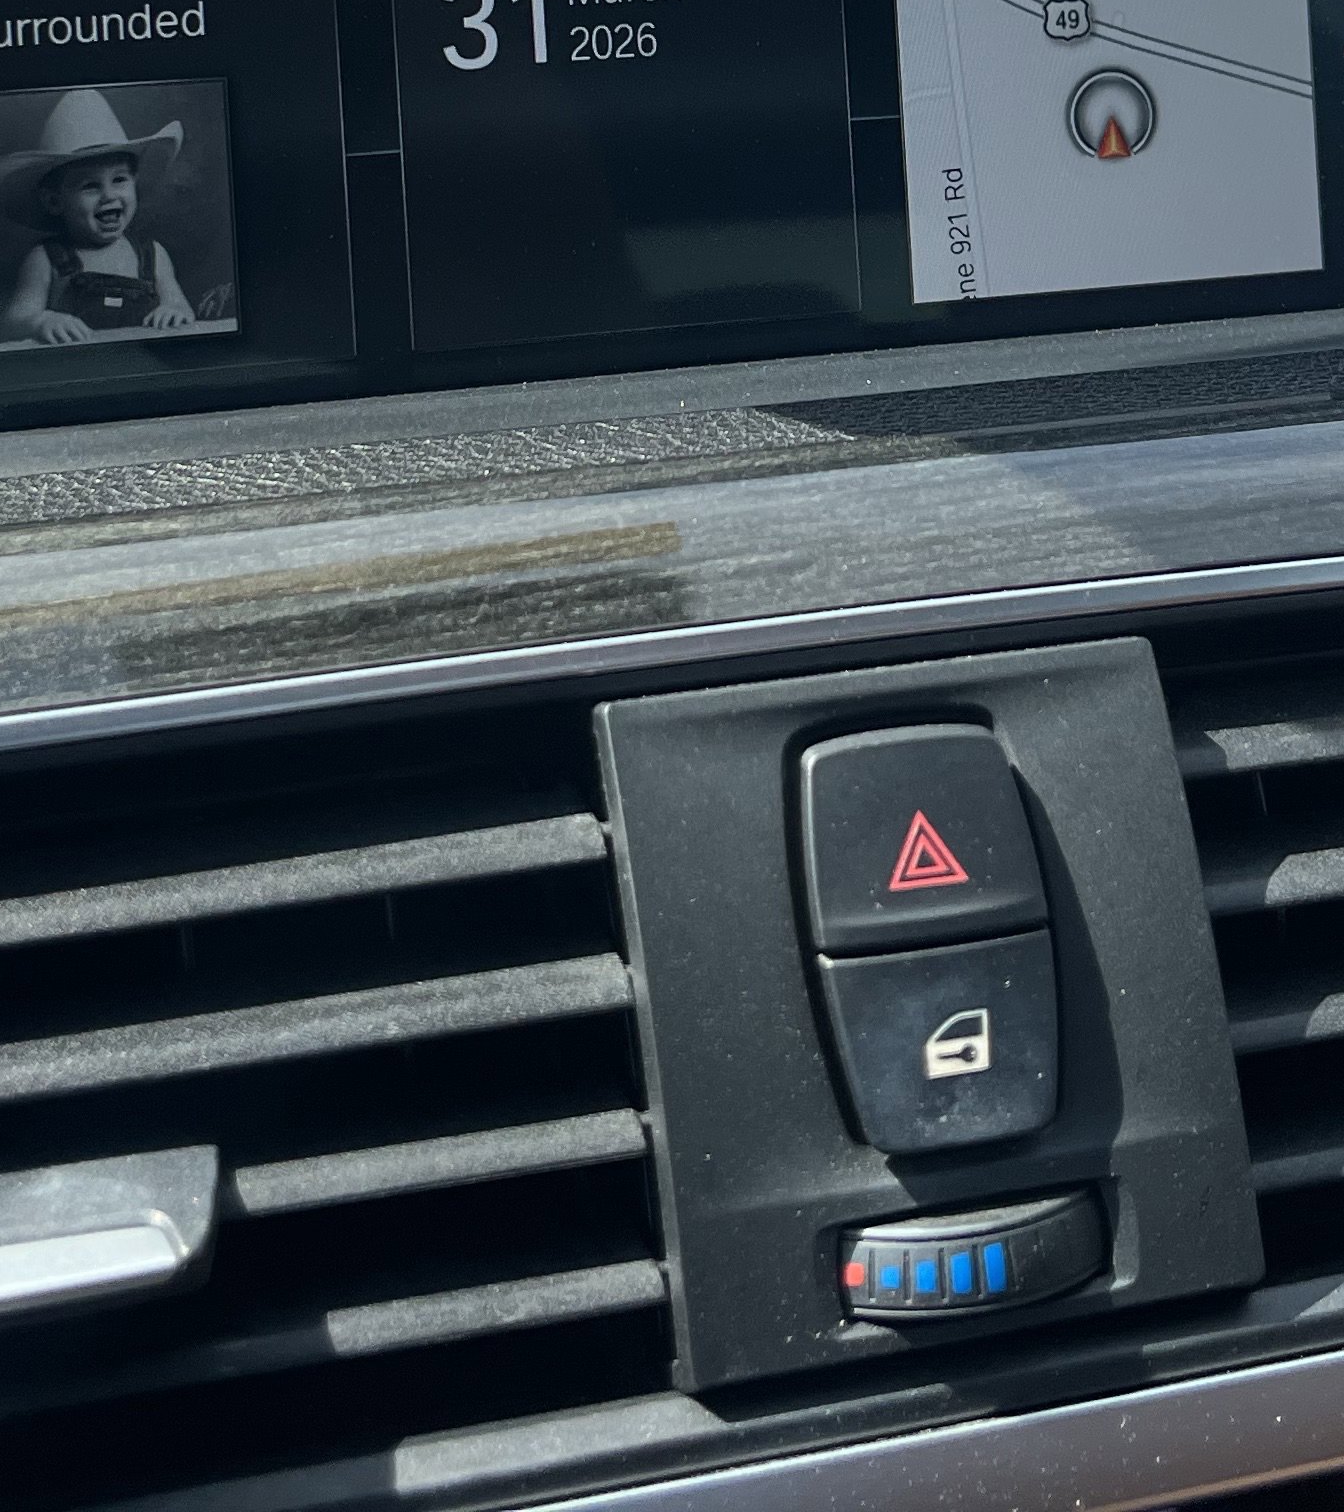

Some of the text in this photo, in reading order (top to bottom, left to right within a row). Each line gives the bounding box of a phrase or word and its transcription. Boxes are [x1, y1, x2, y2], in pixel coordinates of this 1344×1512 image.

[1055, 8, 1080, 31] 49
[569, 20, 659, 62] 2026
[941, 167, 978, 301] ne 921 Rd
